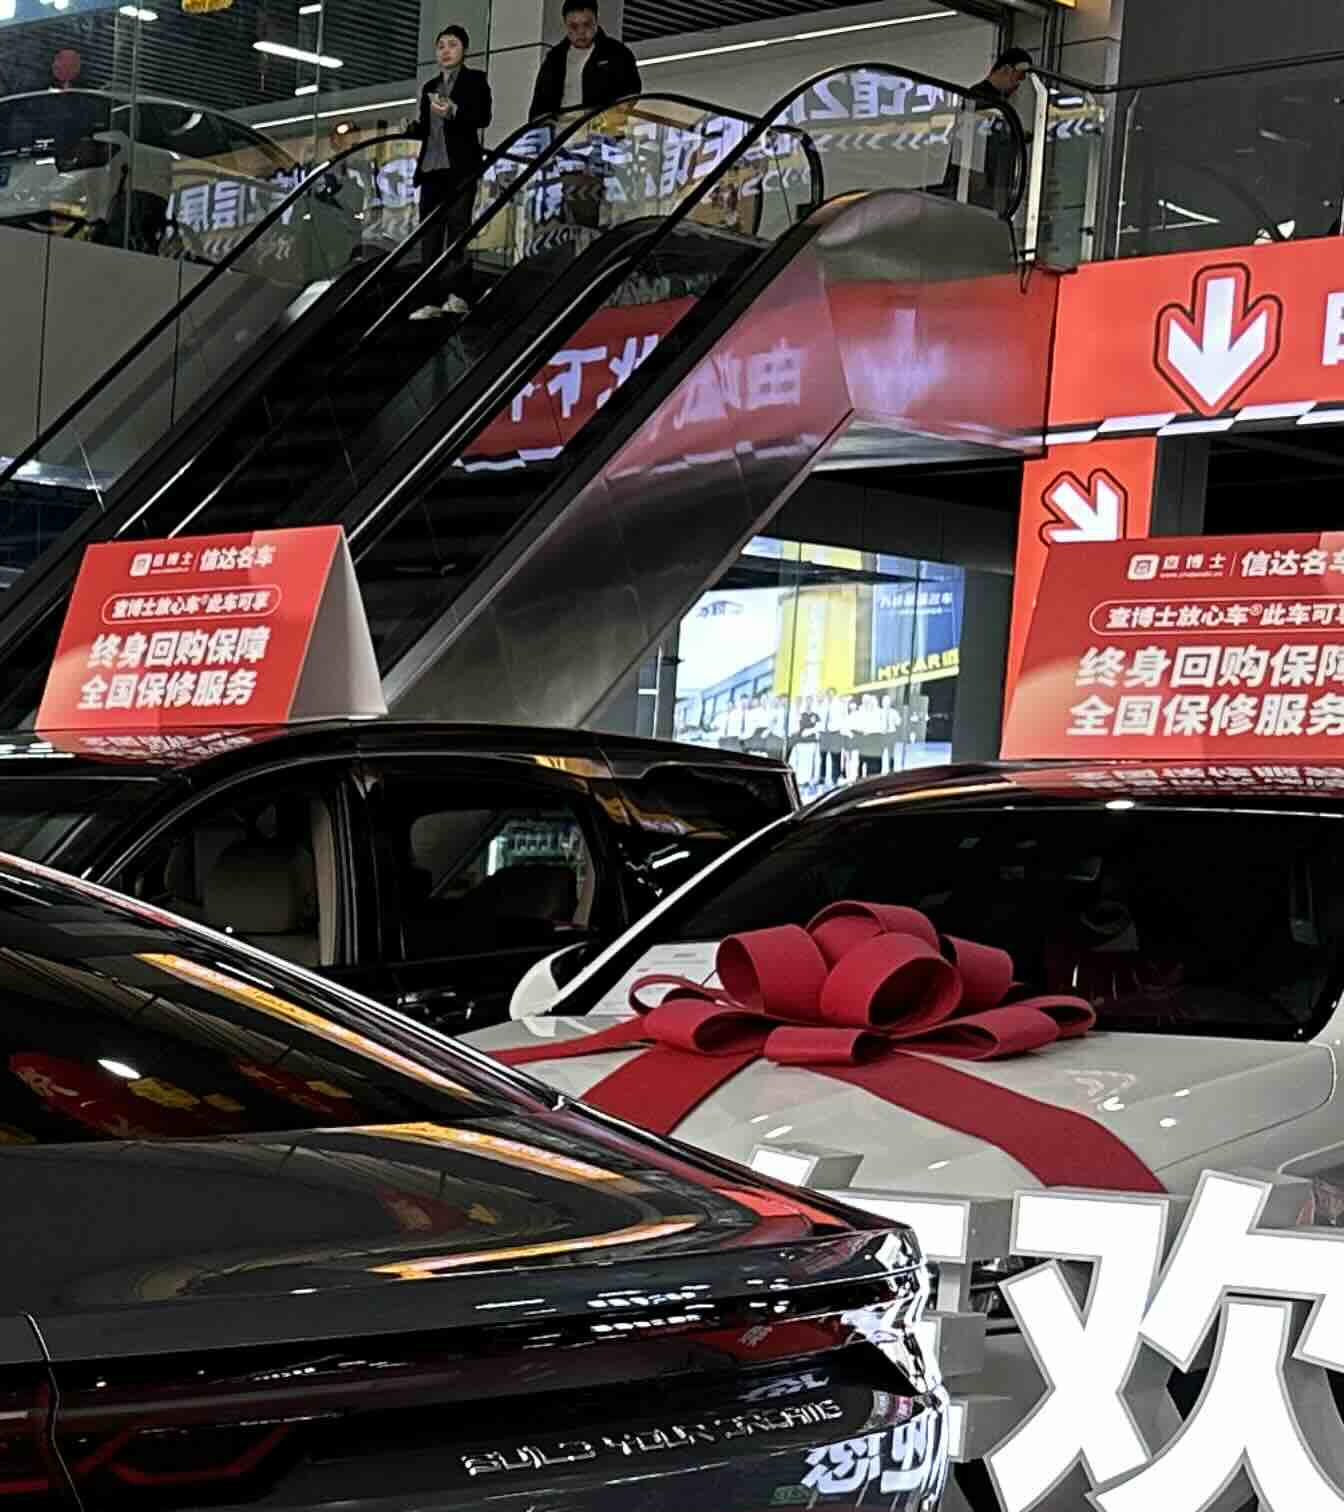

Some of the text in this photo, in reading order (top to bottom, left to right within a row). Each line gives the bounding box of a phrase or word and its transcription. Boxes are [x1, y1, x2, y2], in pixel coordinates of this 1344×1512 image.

[199, 545, 277, 571] 信达名车
[1162, 554, 1227, 570] 查博士
[87, 626, 272, 668] 终身回购保障
[77, 669, 258, 711] 全国保修服务
[1066, 692, 1344, 737] 全国保修服务
